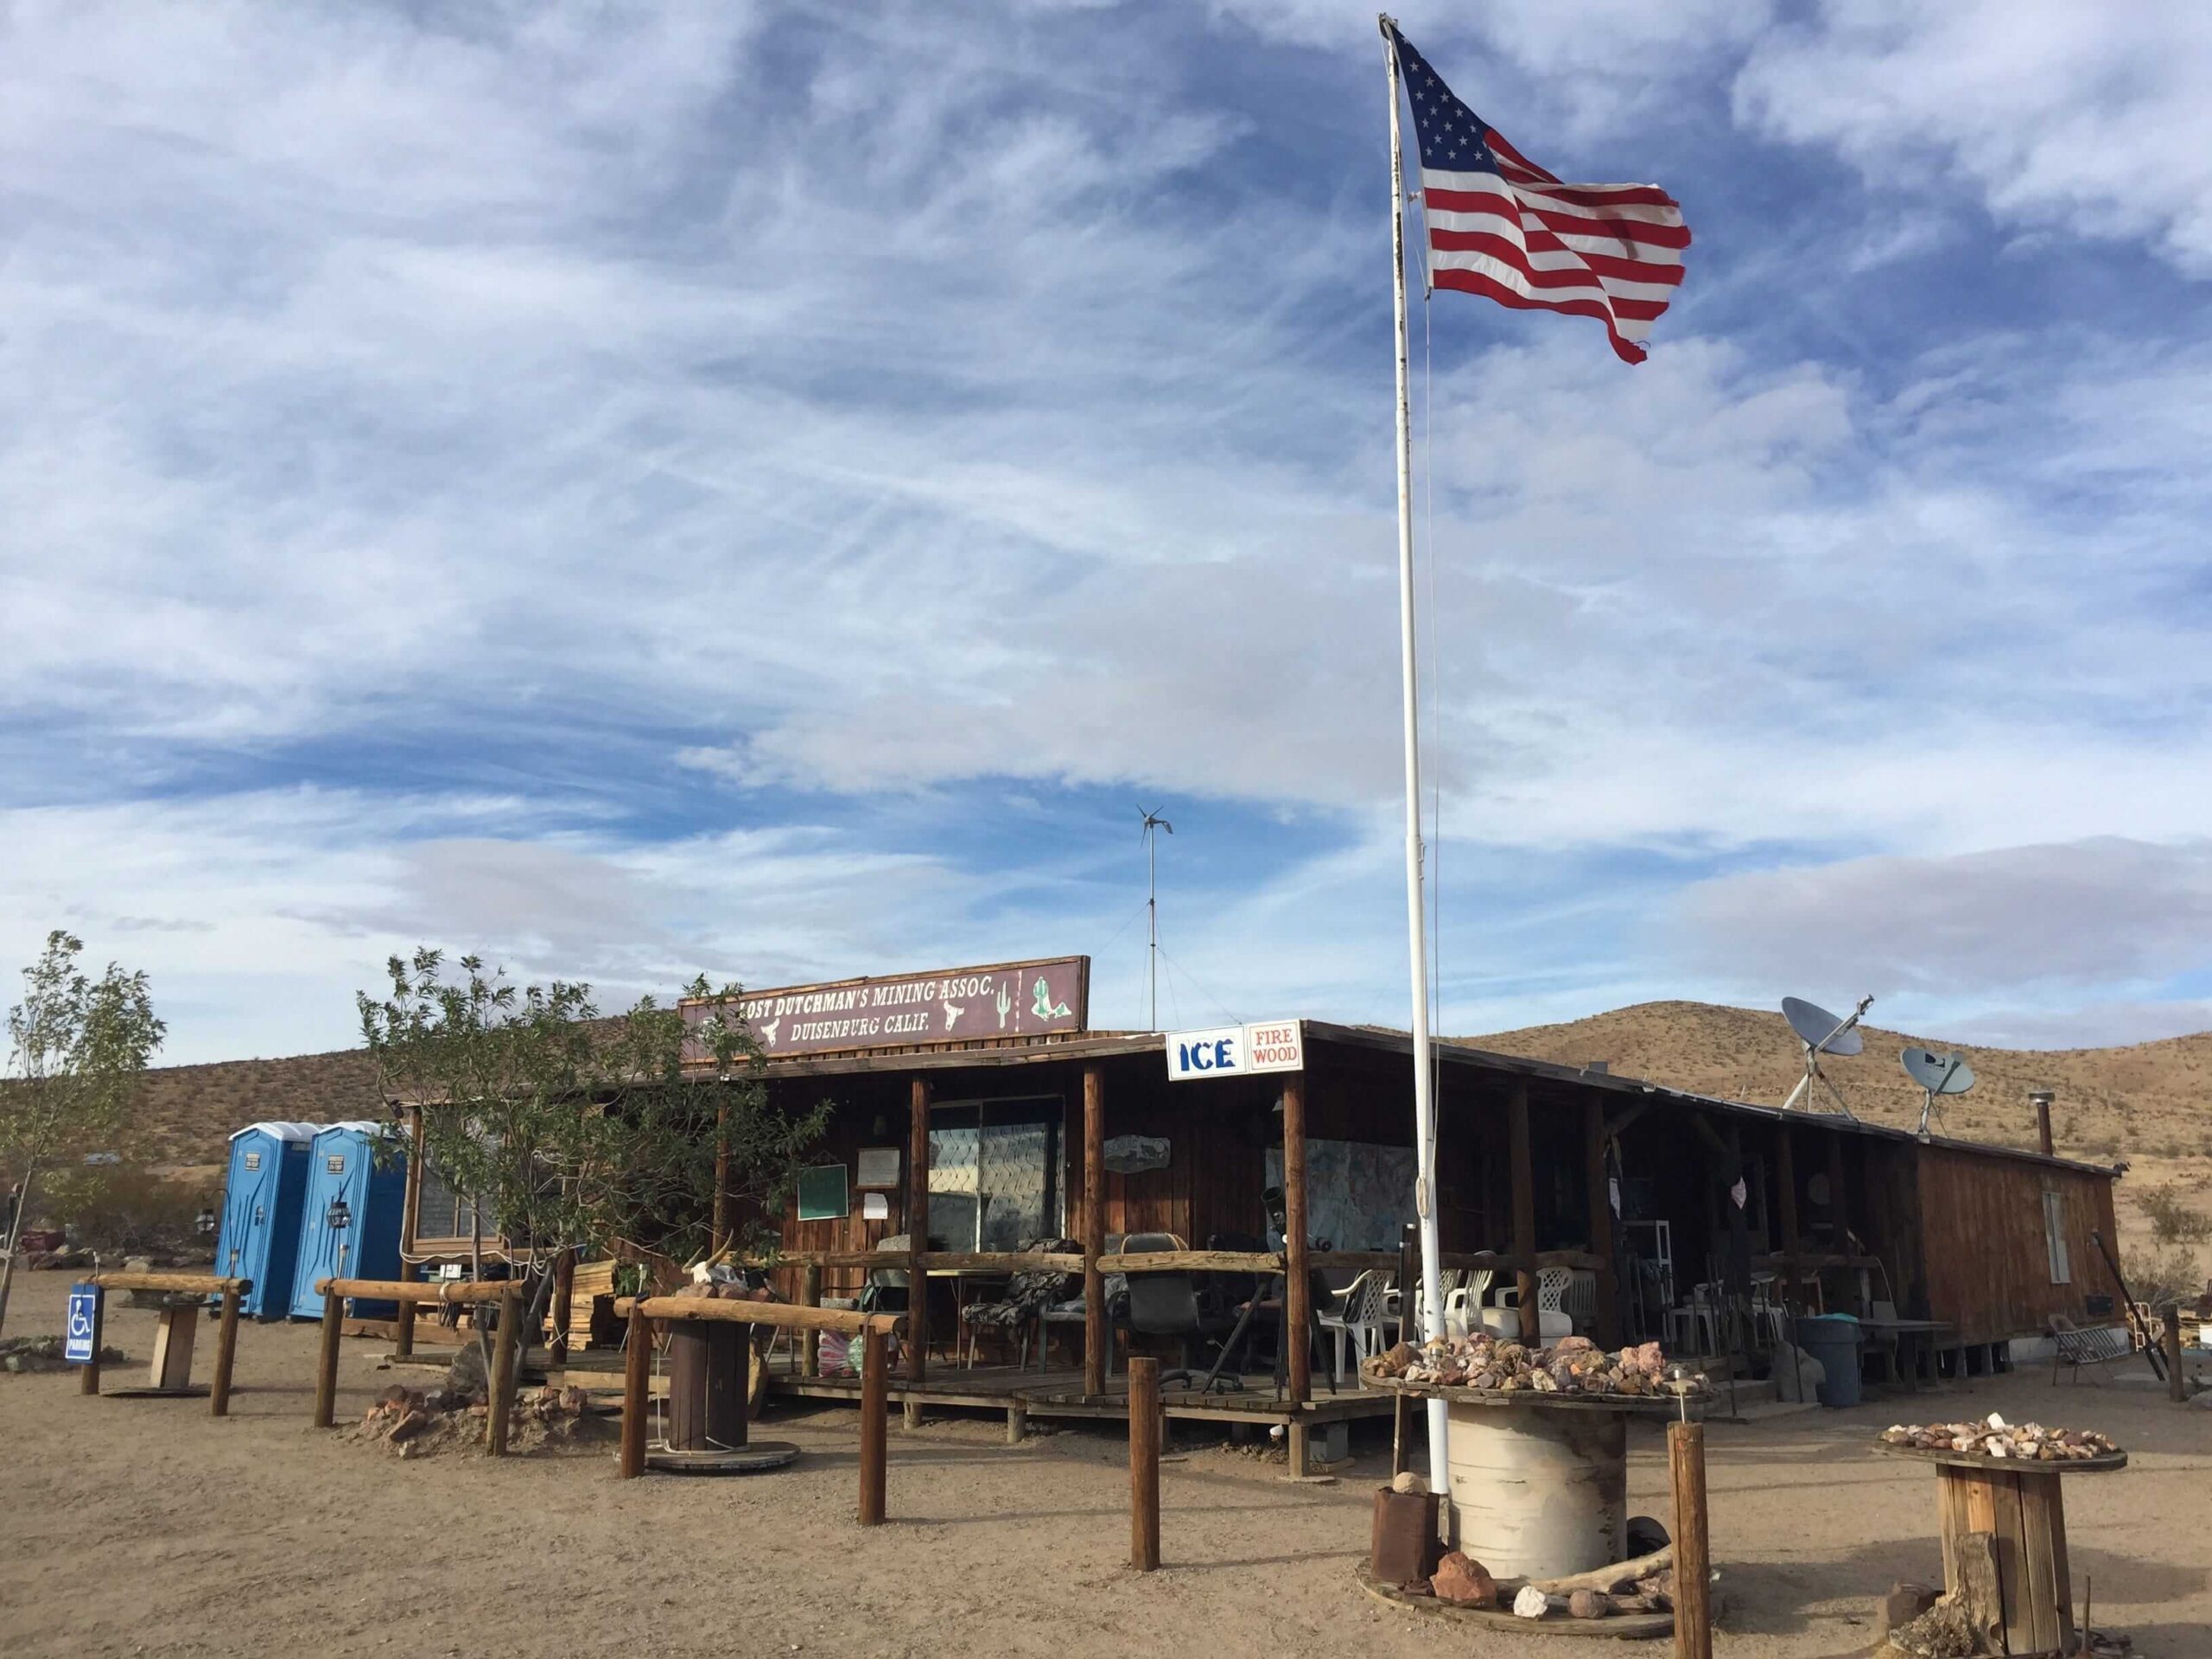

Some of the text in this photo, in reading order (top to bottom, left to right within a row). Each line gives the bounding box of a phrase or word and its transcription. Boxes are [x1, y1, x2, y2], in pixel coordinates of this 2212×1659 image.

[775, 988, 868, 1017] DUTCHMAN'S
[872, 981, 937, 1007] MINING
[938, 976, 995, 1000] ASSOC.
[791, 1012, 929, 1041] DUISENBURG CALIF.
[1255, 1028, 1294, 1046] FIRE
[1180, 1039, 1236, 1071] ICE
[1253, 1046, 1297, 1063] WOOD
[70, 1338, 91, 1351] PARKING
